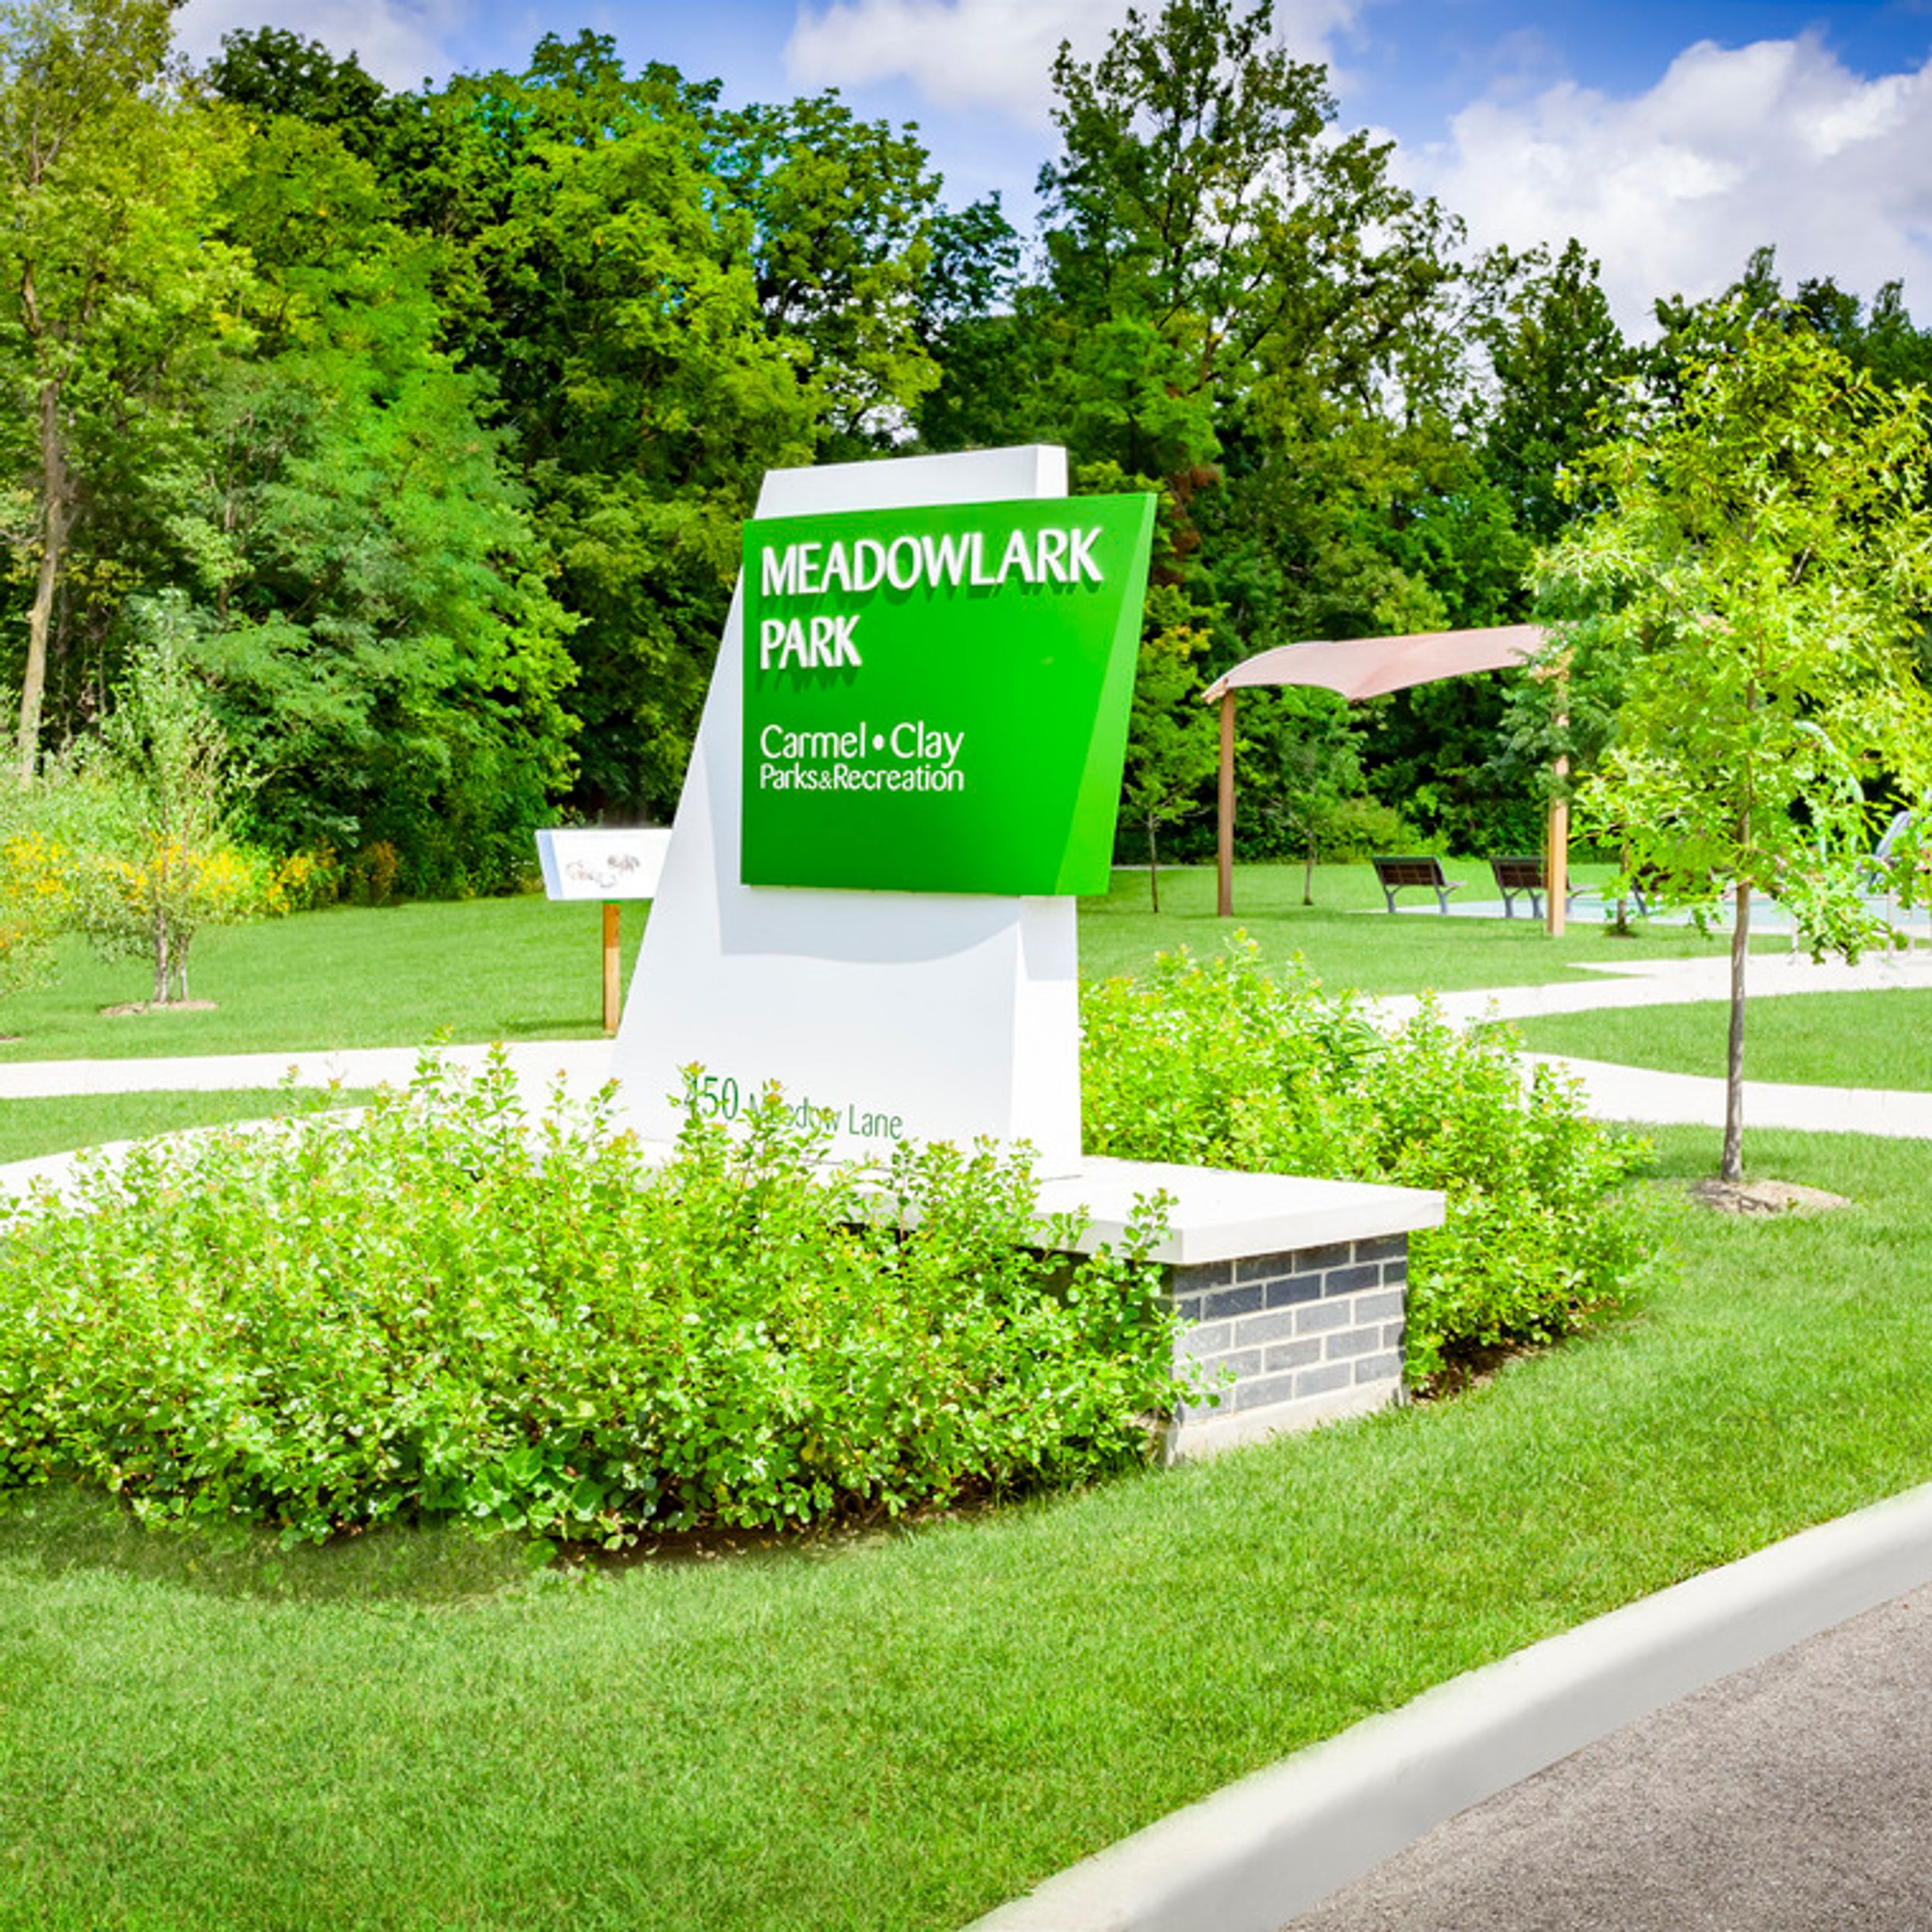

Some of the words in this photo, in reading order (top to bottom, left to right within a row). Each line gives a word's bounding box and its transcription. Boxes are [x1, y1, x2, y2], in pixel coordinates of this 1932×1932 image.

[760, 527, 1103, 597] MEADOWLARK
[760, 615, 862, 670] PARK
[760, 722, 866, 759] Carmel
[890, 720, 964, 768] Clay
[760, 763, 964, 791] Parks&Recreation
[849, 1103, 903, 1140] Lane
